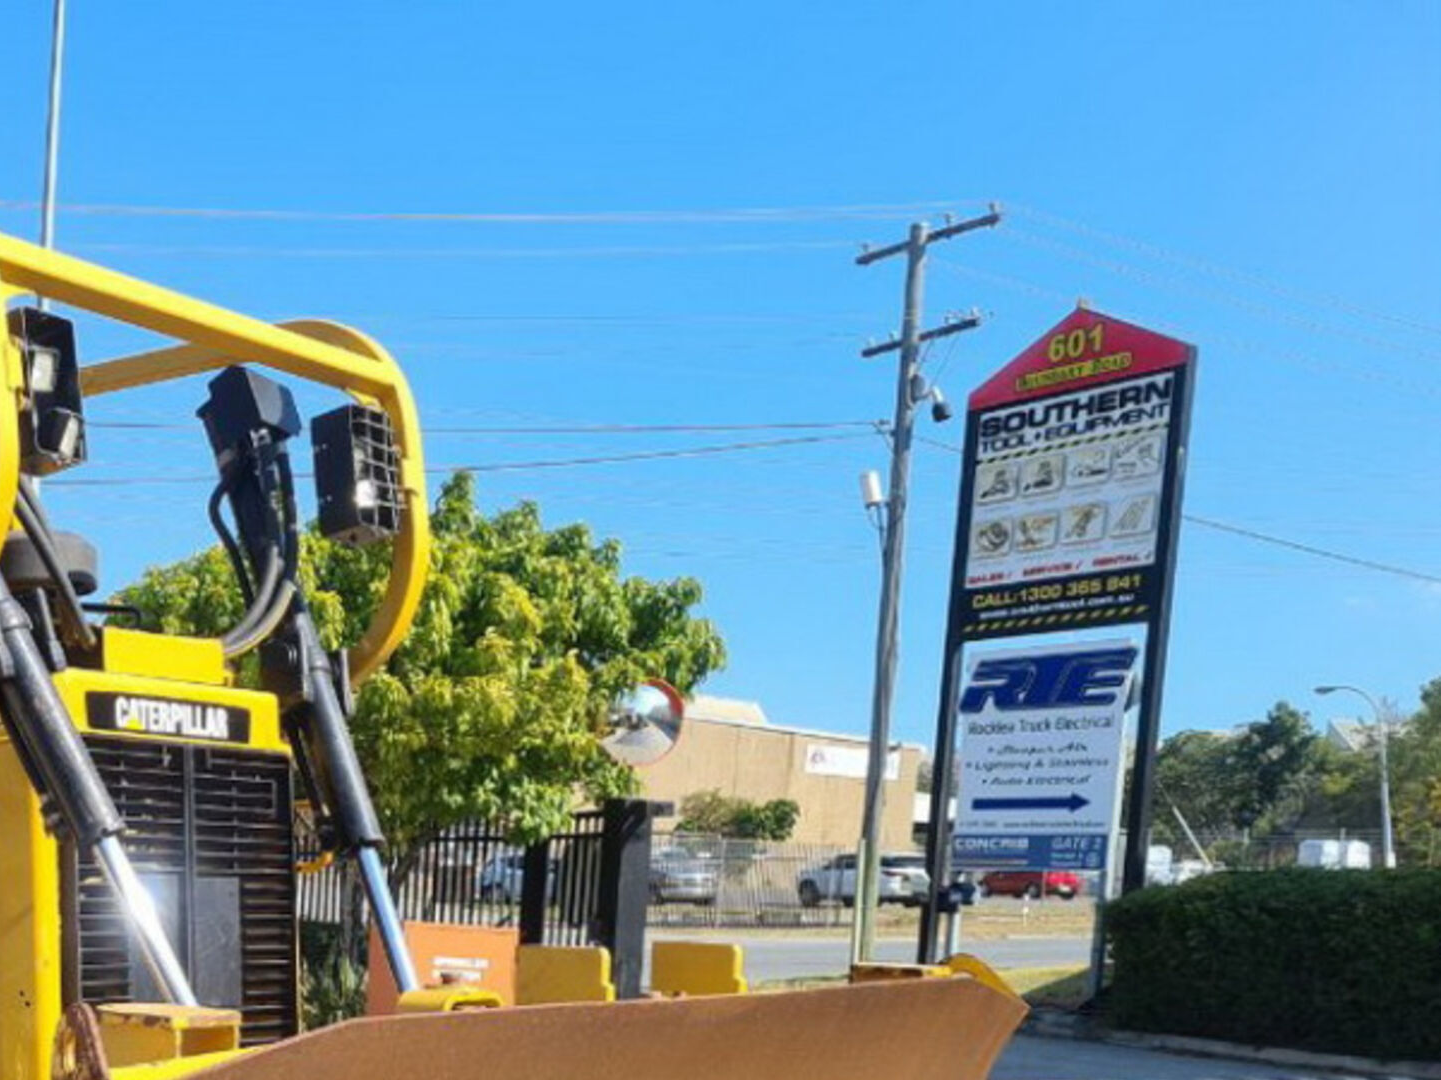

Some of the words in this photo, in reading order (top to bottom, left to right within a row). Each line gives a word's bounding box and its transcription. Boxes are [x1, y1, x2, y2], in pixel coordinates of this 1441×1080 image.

[1049, 323, 1103, 362] 601
[980, 378, 1173, 438] SOUTHERN
[981, 432, 1032, 454] TOOL
[1044, 402, 1170, 441] EQUIPMENT
[115, 695, 229, 739] CATERPILLAR
[1020, 717, 1050, 732] Truck
[1055, 714, 1115, 730] Electrical
